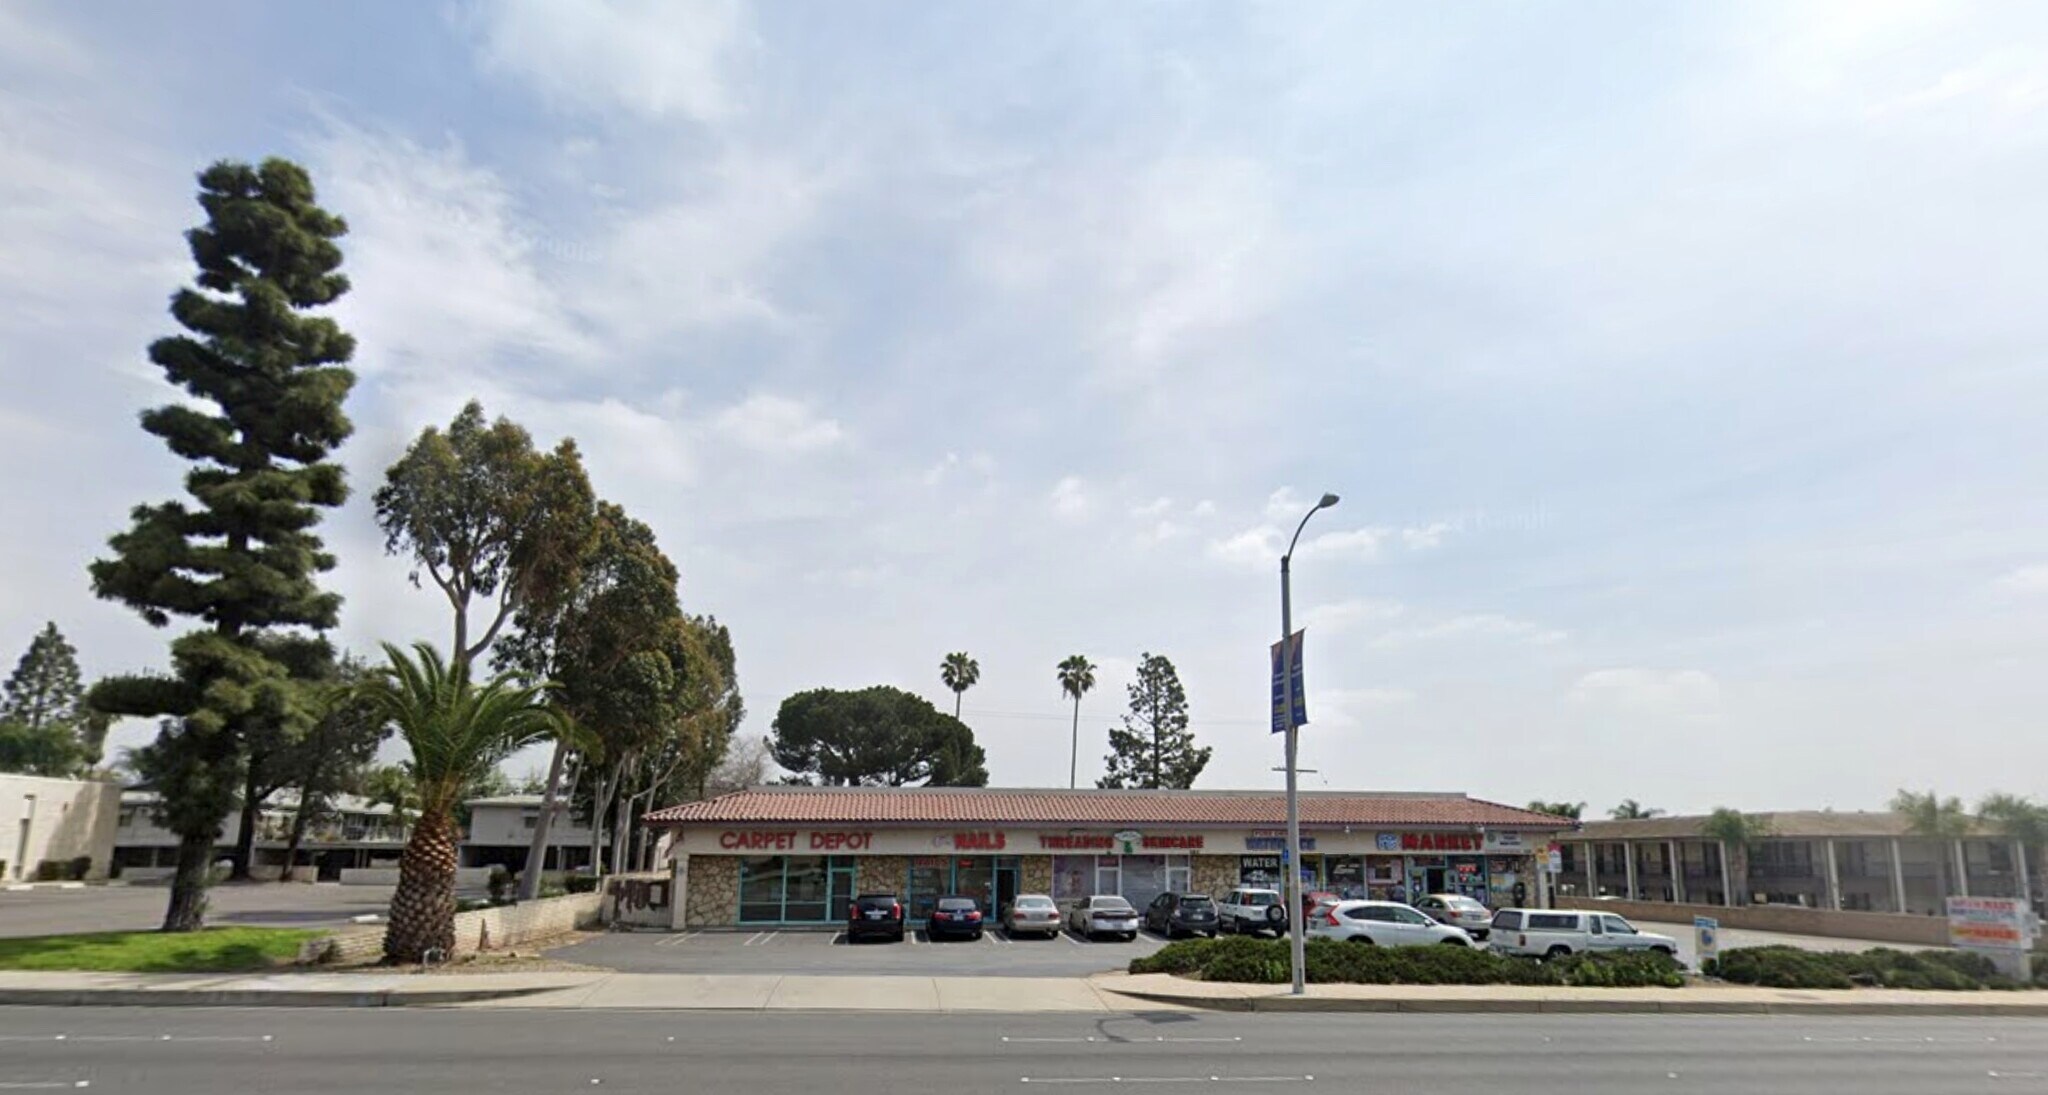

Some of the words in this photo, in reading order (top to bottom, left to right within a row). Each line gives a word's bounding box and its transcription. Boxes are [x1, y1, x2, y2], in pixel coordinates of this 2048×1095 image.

[719, 831, 797, 849] CARPET
[810, 831, 873, 849] DEPOT
[954, 831, 1006, 850] NAILS
[1038, 834, 1114, 849] THREADING
[1402, 832, 1484, 850] MARKET
[1242, 857, 1279, 868] WATER
